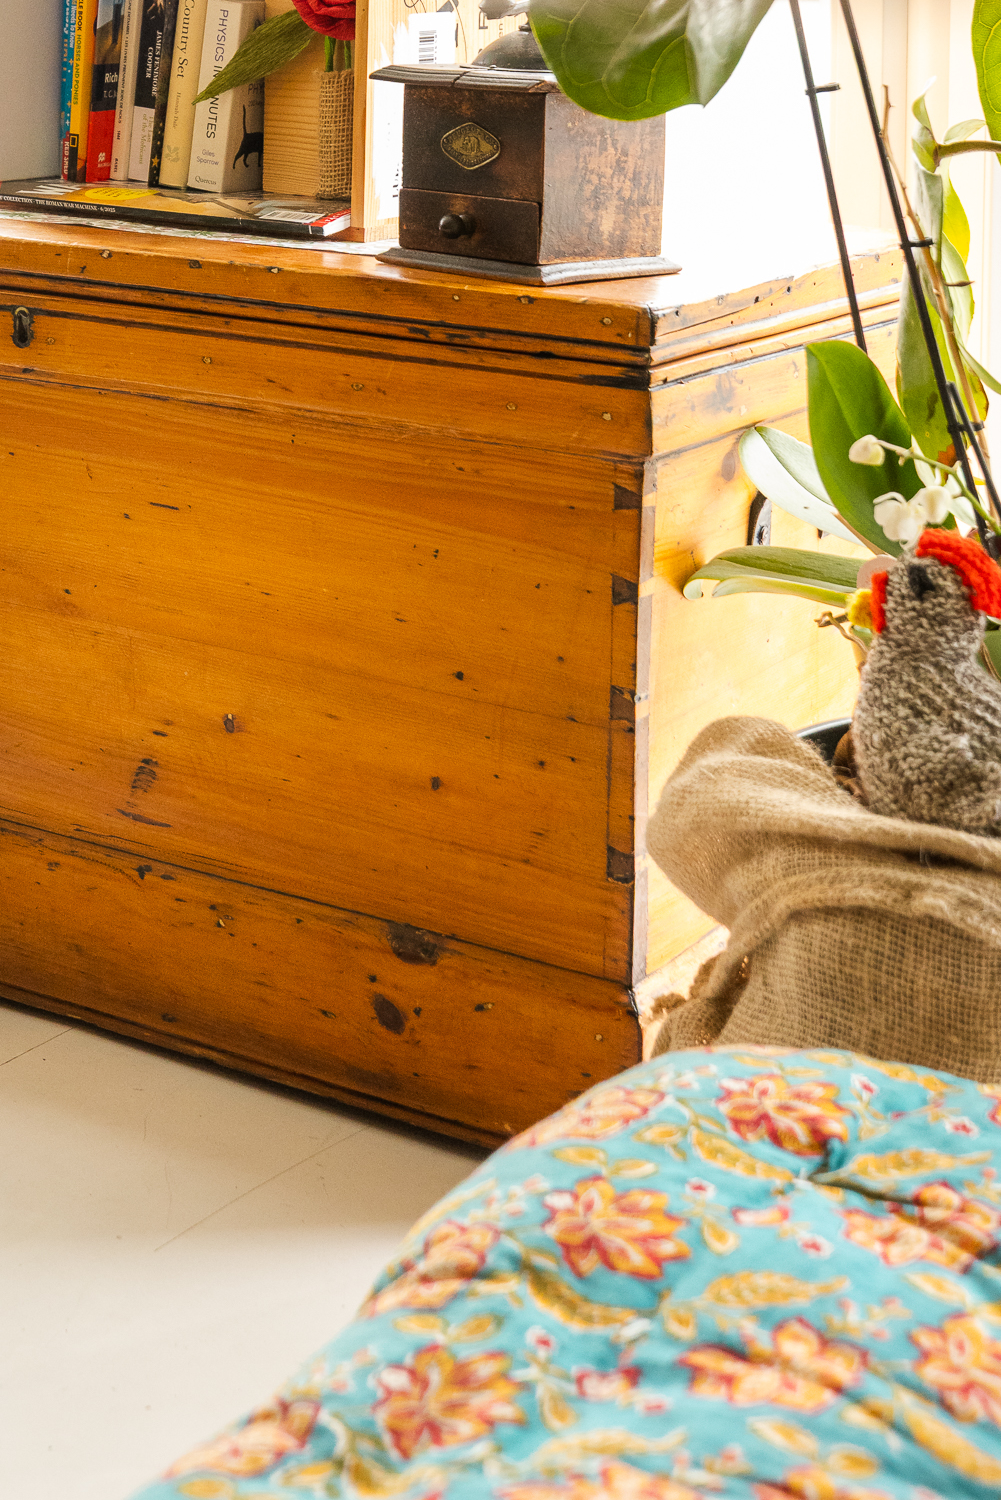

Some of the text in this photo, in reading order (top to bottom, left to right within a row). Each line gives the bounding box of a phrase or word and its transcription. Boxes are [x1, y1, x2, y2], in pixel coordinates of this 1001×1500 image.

[214, 8, 229, 62] PHYSICS
[145, 46, 154, 78] COOPER
[151, 30, 163, 97] JAMES FENIMORE
[176, 56, 189, 79] Set
[196, 155, 220, 166] Sparrow
[201, 149, 216, 158] Giles
[194, 175, 217, 185] Quercus
[3, 194, 33, 204] COLLECTION
